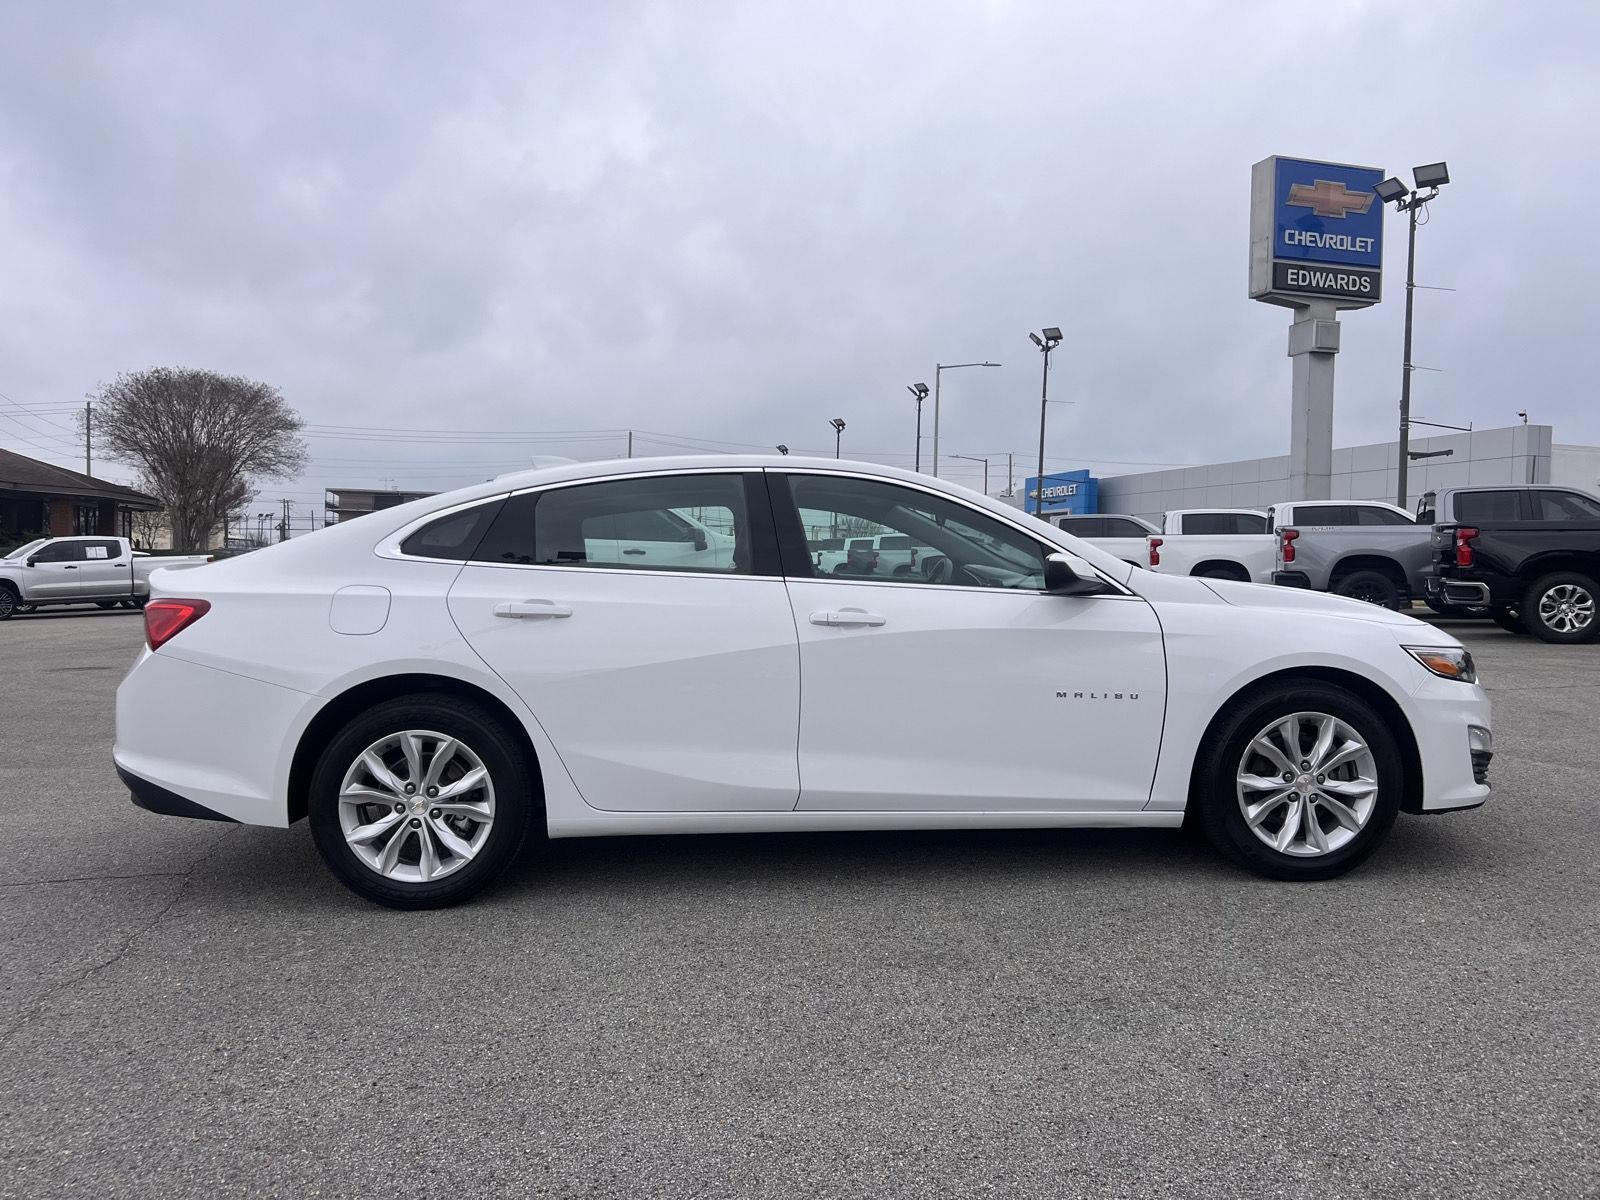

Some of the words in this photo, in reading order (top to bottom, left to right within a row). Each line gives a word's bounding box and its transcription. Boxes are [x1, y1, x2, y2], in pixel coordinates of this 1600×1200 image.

[1284, 229, 1375, 252] CHEVROLET
[1287, 269, 1371, 292] EDWARDS
[1041, 484, 1077, 498] CHEVROLET
[1056, 691, 1139, 700] MALIBU
